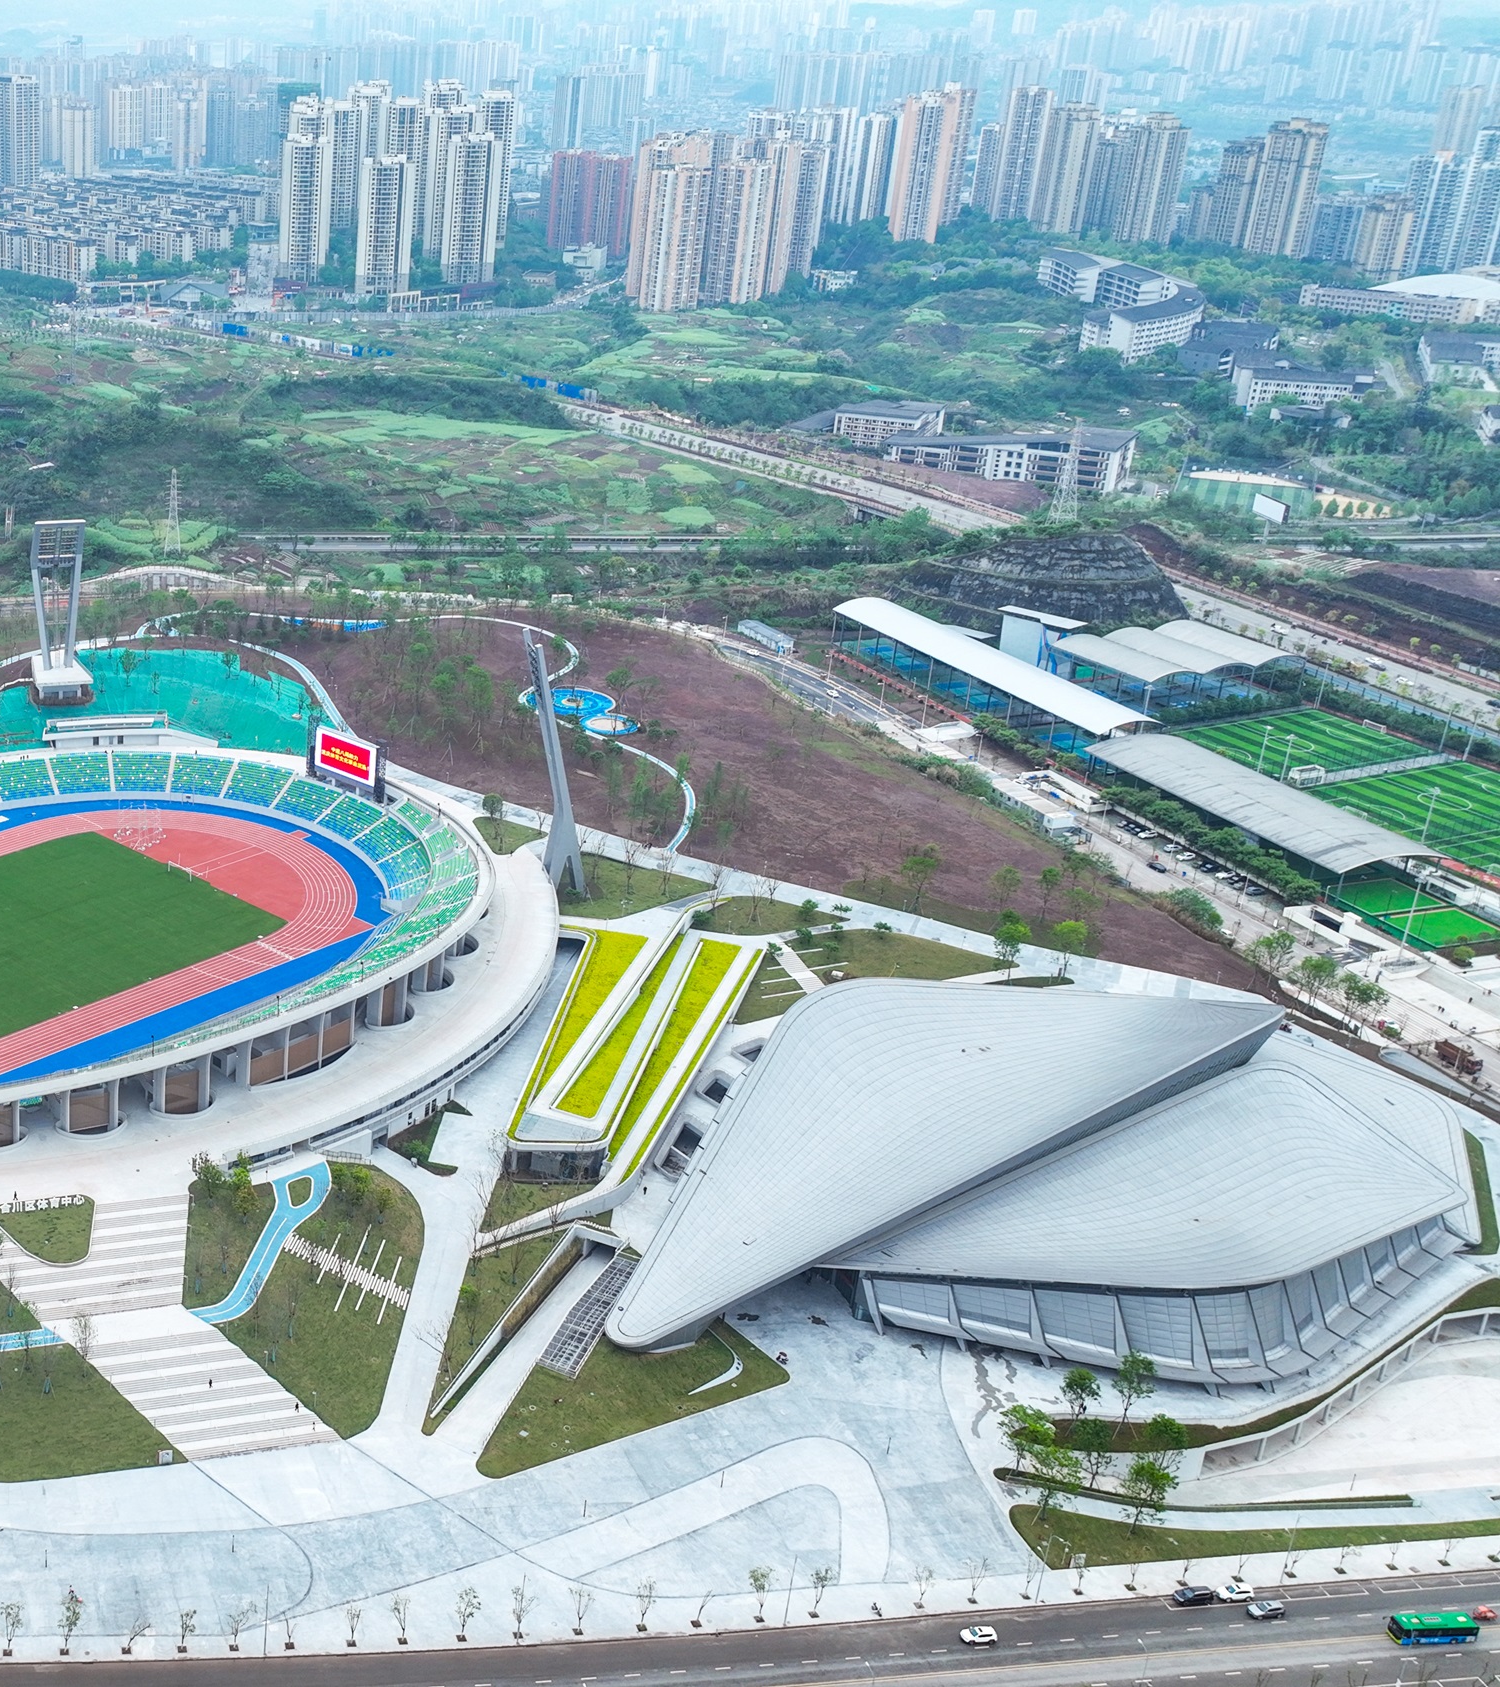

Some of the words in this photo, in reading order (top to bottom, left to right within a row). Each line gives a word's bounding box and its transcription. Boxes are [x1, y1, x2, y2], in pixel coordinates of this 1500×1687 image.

[0, 1194, 85, 1214] 合川区体育中心
